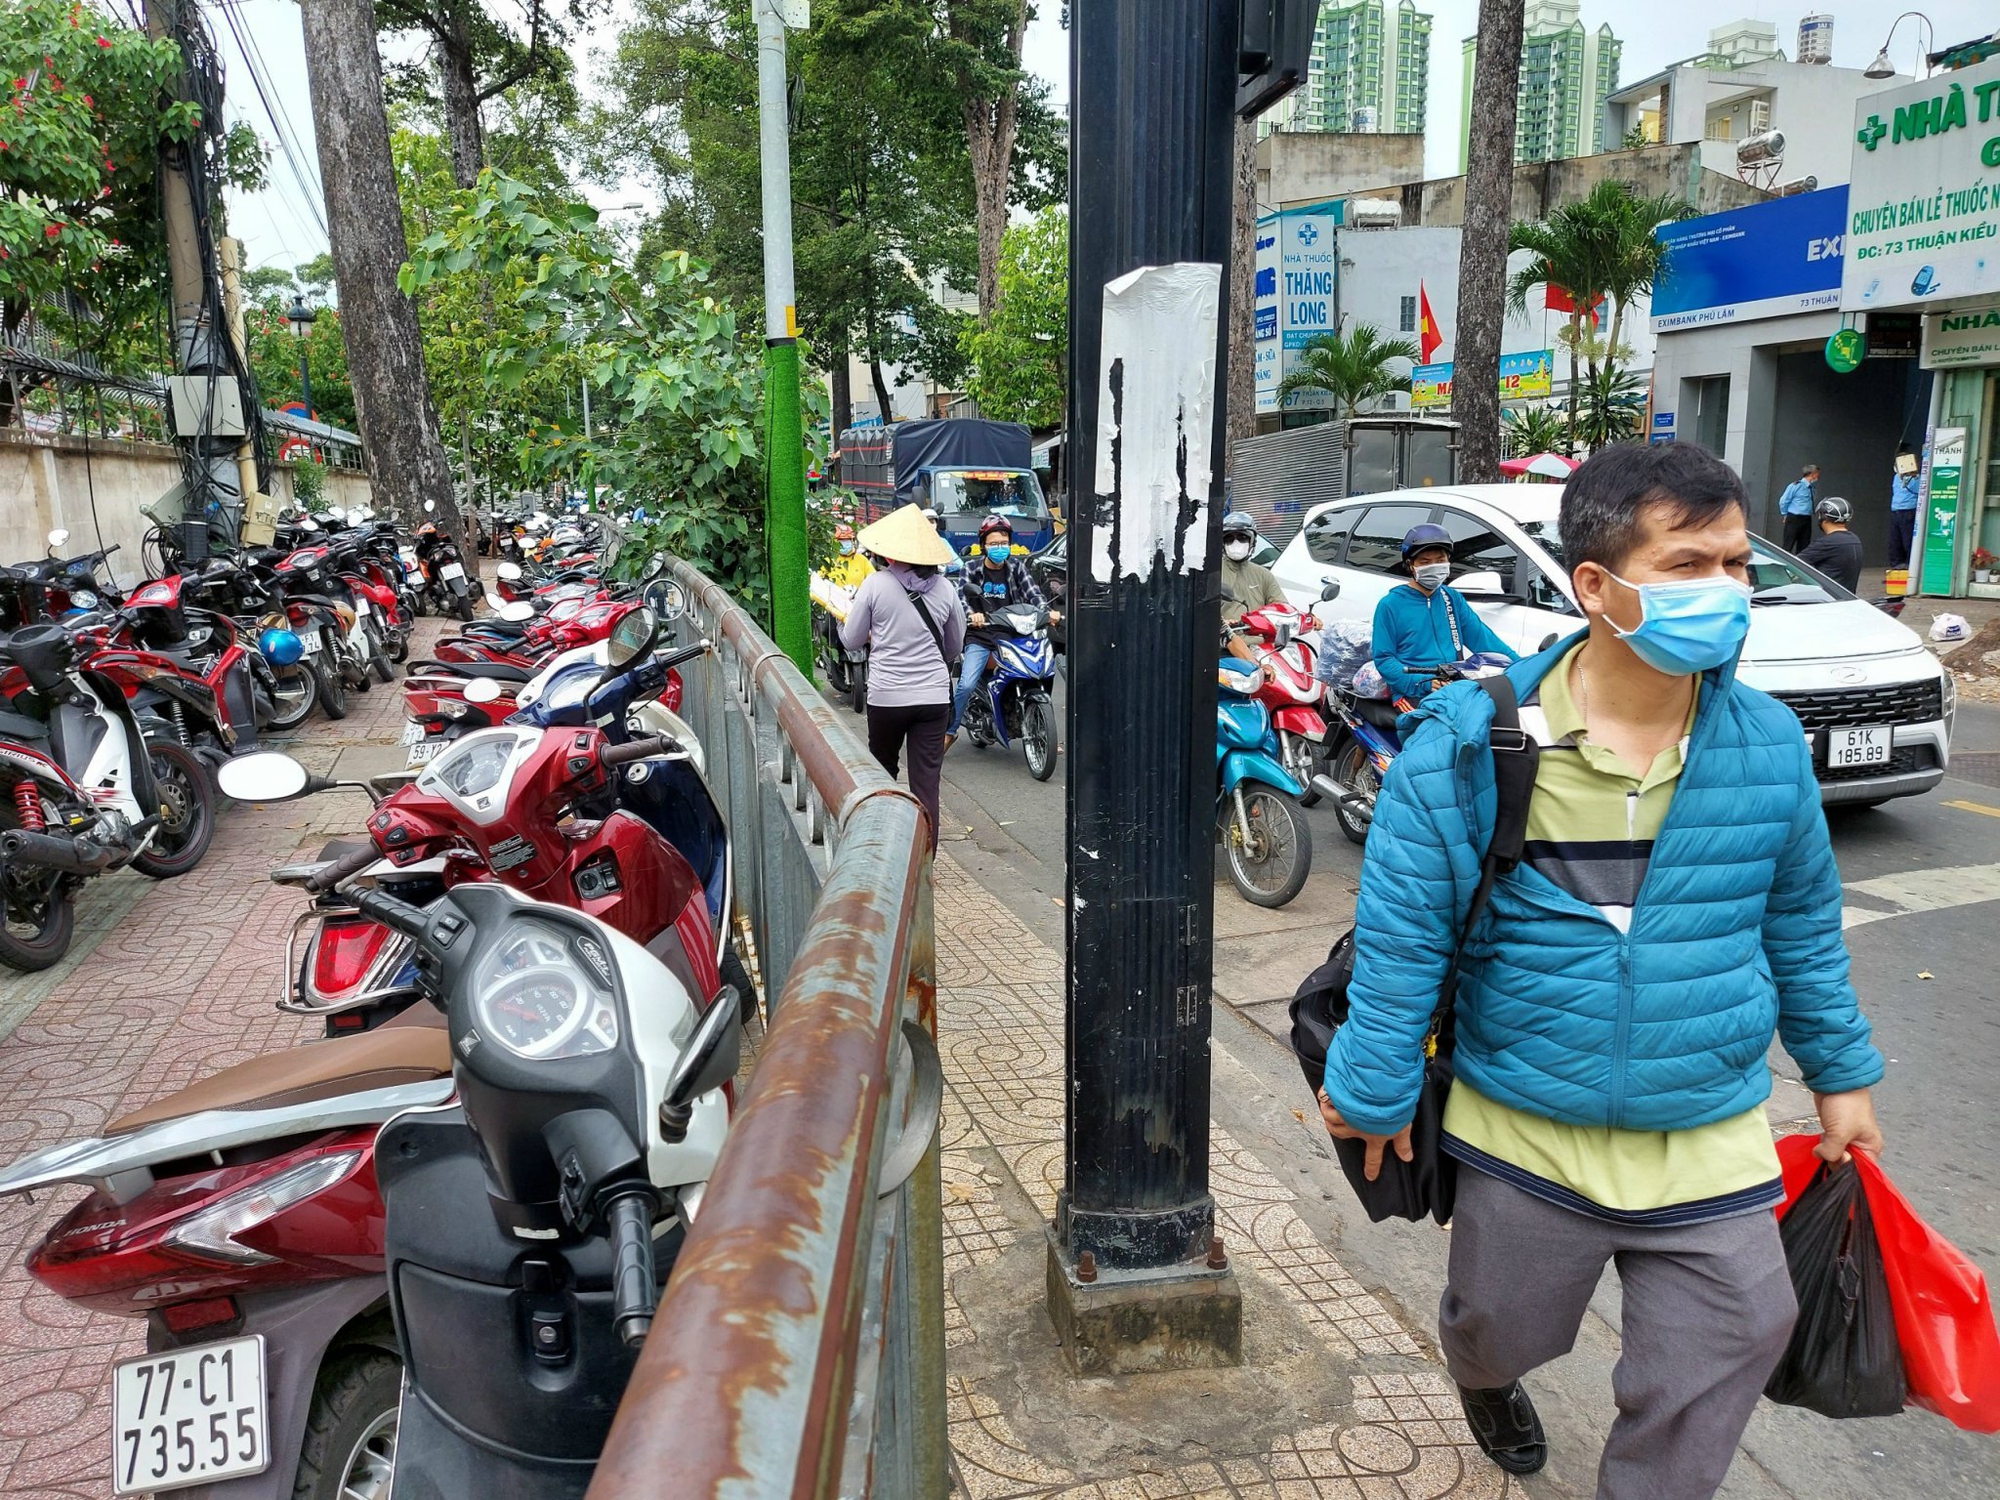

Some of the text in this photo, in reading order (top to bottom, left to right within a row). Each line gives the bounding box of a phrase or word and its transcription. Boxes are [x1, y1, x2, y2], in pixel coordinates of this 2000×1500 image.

[1892, 80, 2000, 144] NHÀ T
[1853, 201, 1897, 236] CHUYÊN
[1899, 195, 1924, 228] BÁN
[1926, 187, 1942, 222] LẺ
[1946, 178, 1988, 218] THUỐC
[1858, 246, 1881, 260] ĐC:
[1885, 241, 1902, 255] 73
[1906, 231, 1956, 250] THUẬN
[1284, 251, 1332, 263] NHÀ THUỐC
[1285, 267, 1332, 295] THĂNG
[1800, 294, 1838, 307] 73 THUẬN
[1291, 301, 1326, 325] LONG
[1658, 314, 1697, 328] EXIMBANK
[1717, 309, 1735, 320] LÂM
[1931, 345, 1969, 357] CHUYÊN
[1848, 730, 1873, 746] 61K
[1838, 746, 1883, 764] 185.89
[63, 1219, 127, 1238] HONDA
[136, 1349, 234, 1420] 77-C1
[124, 1407, 256, 1484] 735.55
